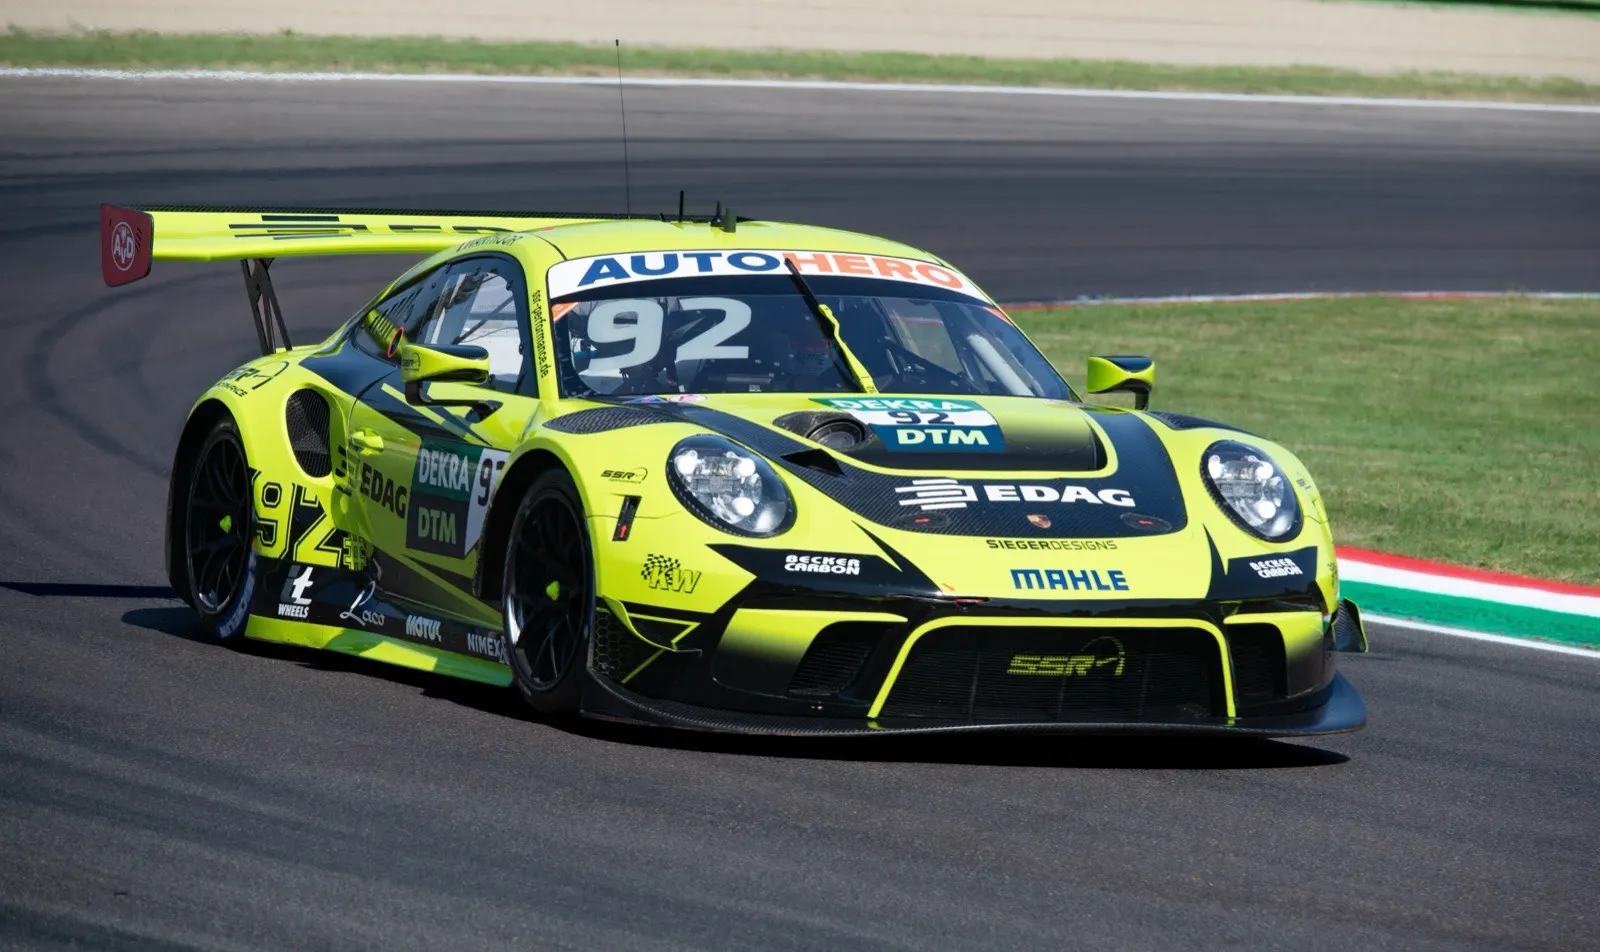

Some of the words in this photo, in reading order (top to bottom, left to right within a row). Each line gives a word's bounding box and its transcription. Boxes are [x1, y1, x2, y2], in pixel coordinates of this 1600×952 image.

[577, 252, 963, 289] AUTOHERO
[532, 289, 552, 379] ssr-performance.de
[585, 297, 752, 375] 92
[828, 399, 975, 411] DEKRA
[888, 411, 955, 425] 92
[896, 429, 989, 446] DTM
[418, 448, 470, 492] DEKRA
[601, 469, 636, 480] SSR
[360, 462, 408, 519] EDAG
[478, 458, 506, 507] 9
[983, 485, 1137, 508] EDAG
[252, 468, 342, 568] 92
[418, 506, 457, 545] DTM
[986, 539, 1118, 550] SIEGERDESIGNS
[784, 562, 861, 575] CARBON
[785, 554, 861, 568] BECKER
[1249, 557, 1296, 571] BECKER
[1257, 566, 1304, 578] CARBON
[649, 565, 702, 594] KW
[1010, 569, 1130, 591] MAHLE
[278, 603, 310, 618] WHEELS
[405, 615, 442, 642] MOTUL
[1006, 655, 1096, 676] SSR
